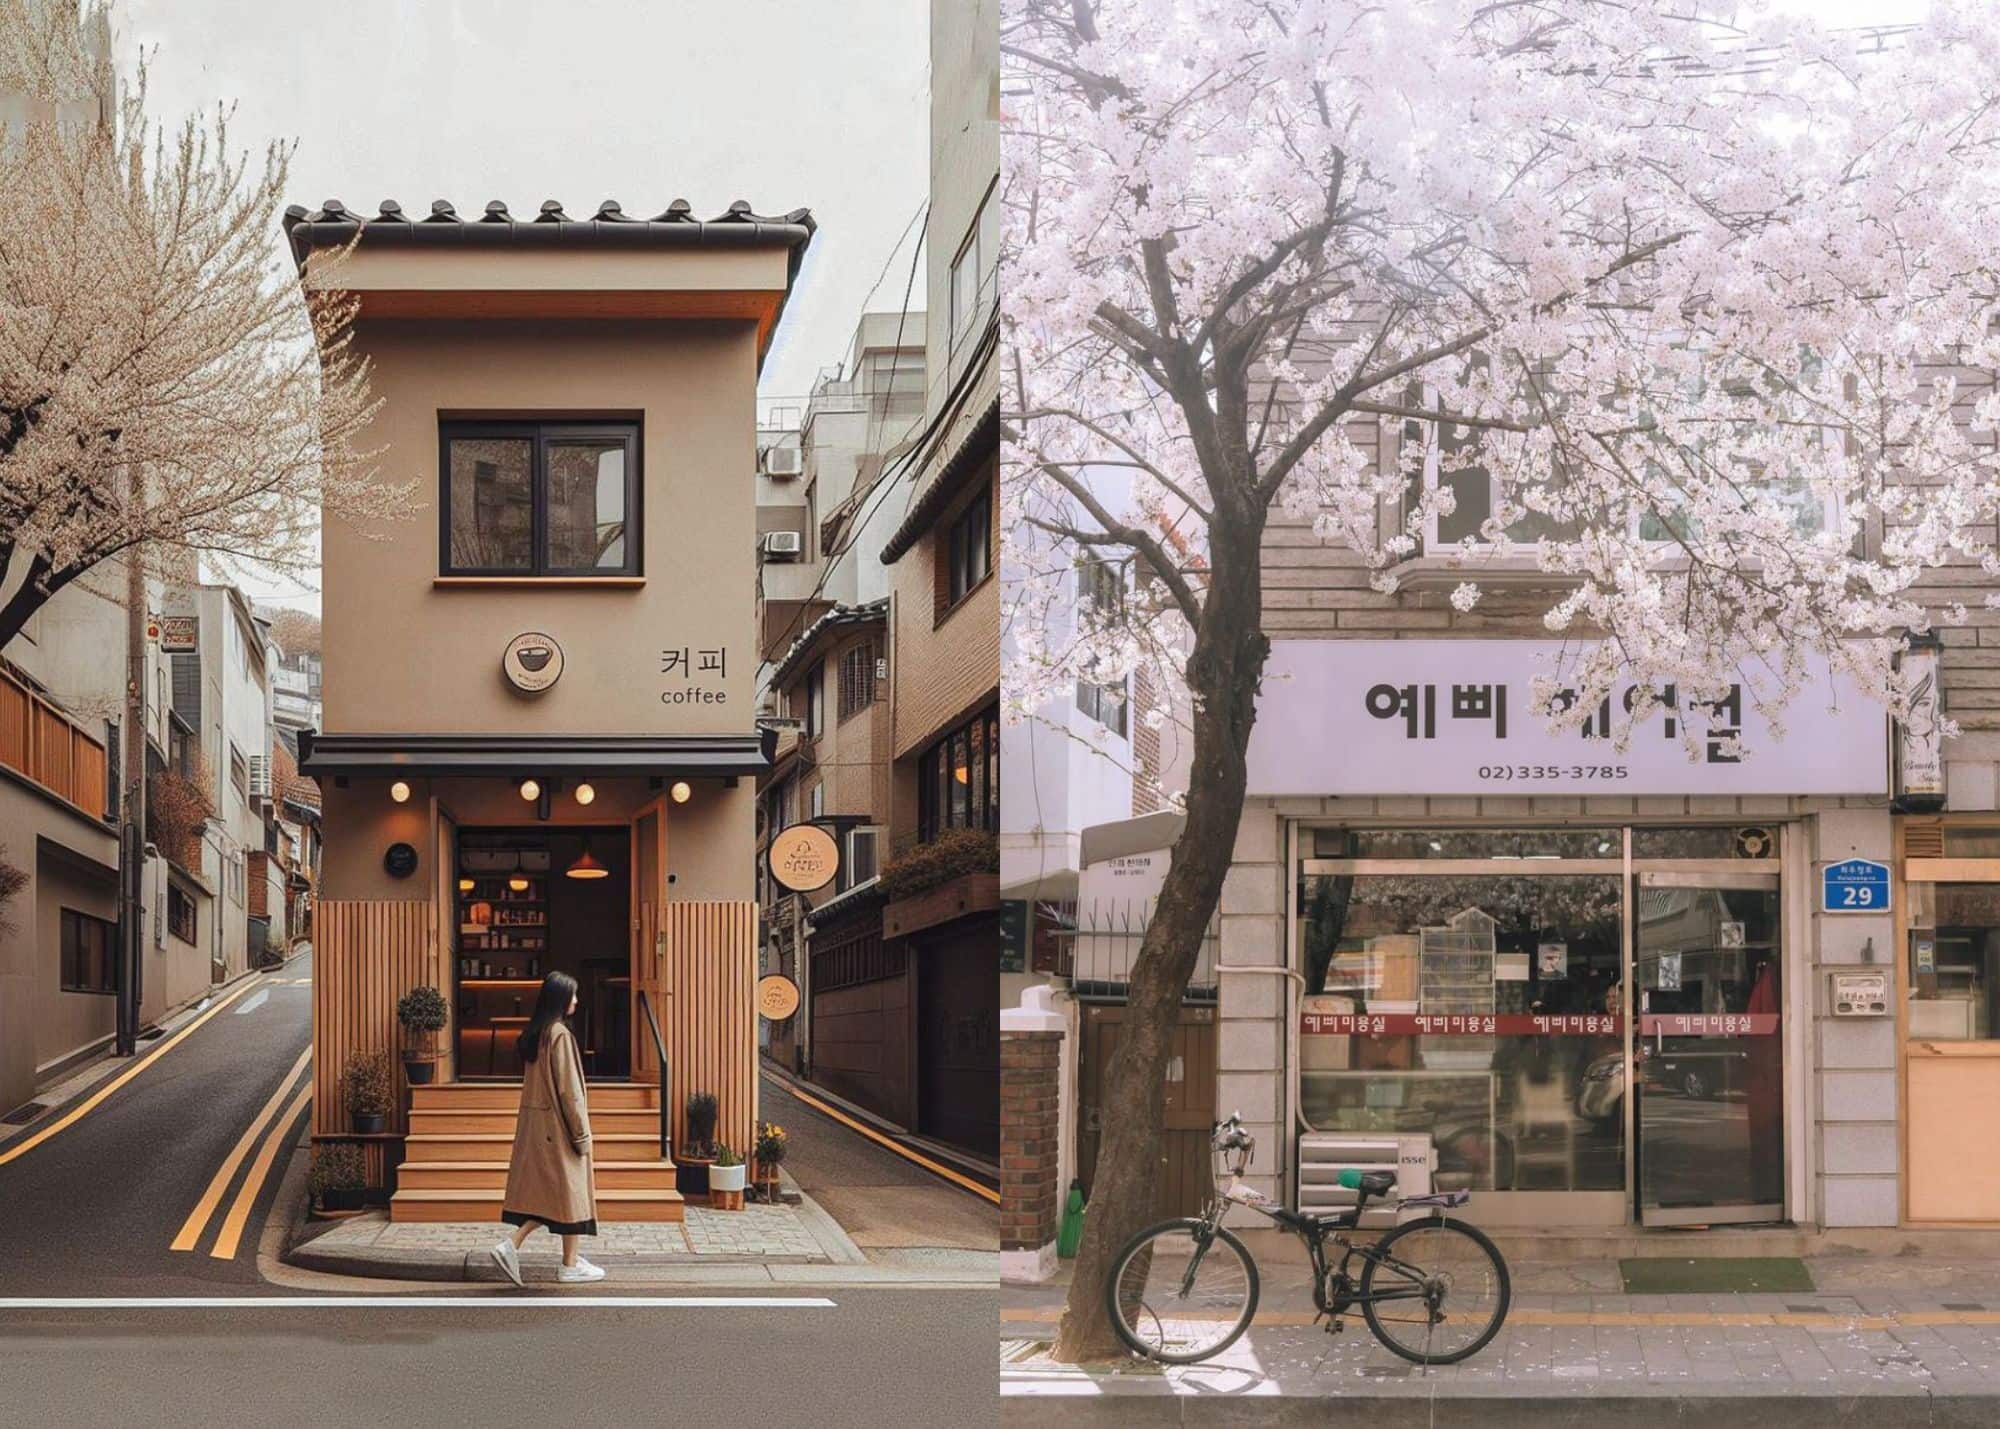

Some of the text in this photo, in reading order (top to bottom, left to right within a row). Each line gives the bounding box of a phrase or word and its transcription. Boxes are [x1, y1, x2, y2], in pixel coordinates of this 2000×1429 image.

[661, 647, 726, 679] 커피
[661, 687, 727, 704] coffee
[1365, 683, 1507, 739] 예삐
[1478, 765, 1628, 781] 02)335-3785
[1843, 887, 1872, 905] 29
[1342, 1016, 1386, 1033] 미용실
[1452, 1016, 1496, 1033] 미용실
[1571, 1016, 1614, 1033] 미용실
[1711, 1016, 1752, 1033] 미용실
